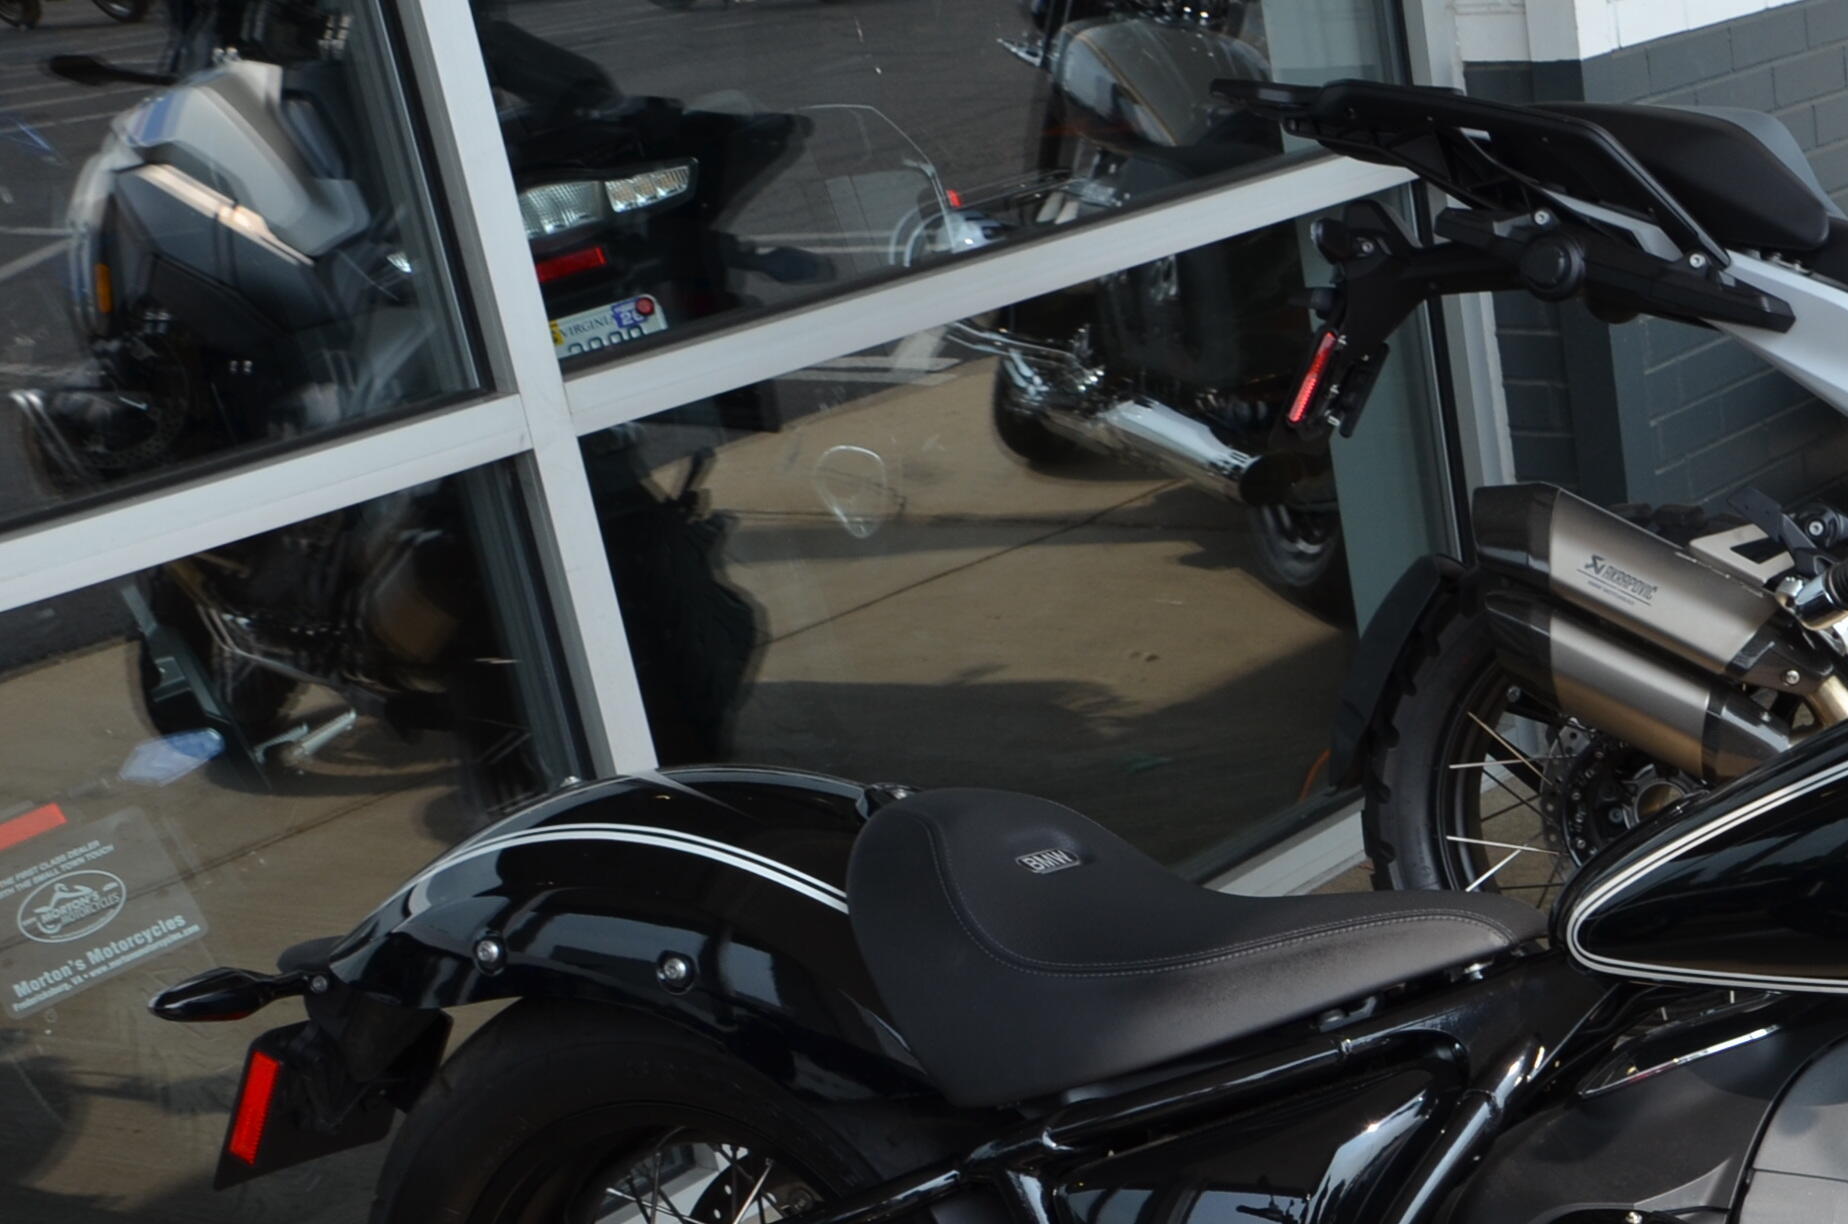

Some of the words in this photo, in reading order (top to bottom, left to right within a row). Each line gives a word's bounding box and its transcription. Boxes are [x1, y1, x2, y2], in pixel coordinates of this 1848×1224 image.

[1020, 849, 1073, 870] BMW
[12, 958, 87, 998] Morton's
[86, 915, 186, 965] Motorcycles
